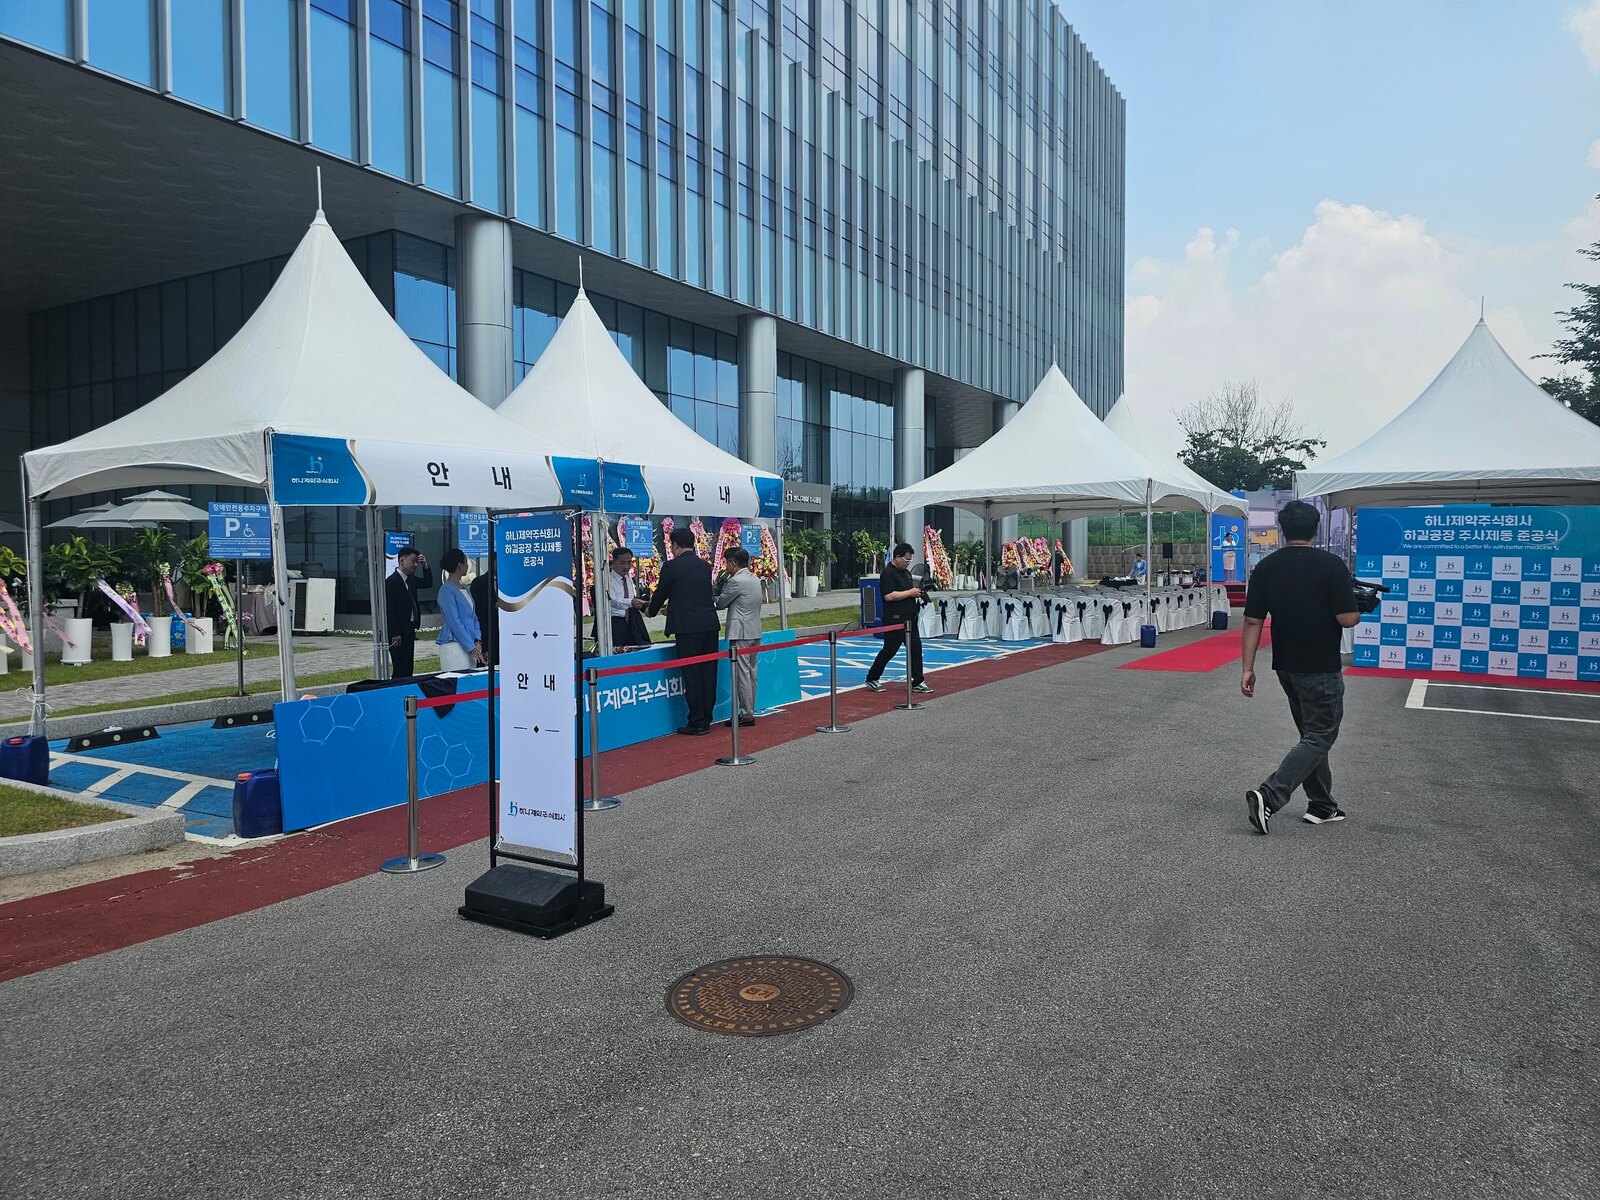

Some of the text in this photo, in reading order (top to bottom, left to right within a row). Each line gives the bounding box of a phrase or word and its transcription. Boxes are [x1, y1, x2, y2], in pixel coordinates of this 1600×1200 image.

[427, 462, 512, 490] 안 내
[683, 482, 731, 504] 안 내
[212, 503, 267, 513] 장애인전용주차구역
[1424, 514, 1533, 527] 하나제약주식회사
[225, 517, 240, 538] P
[468, 524, 480, 540] P
[505, 528, 561, 541] 하나제약주식회사
[632, 529, 640, 543] P
[1404, 529, 1559, 542] 하길공장 주사제동 준공식
[504, 541, 562, 554] 하길공장 주사제동
[523, 556, 544, 567] 준공식
[517, 673, 556, 691] 안 내
